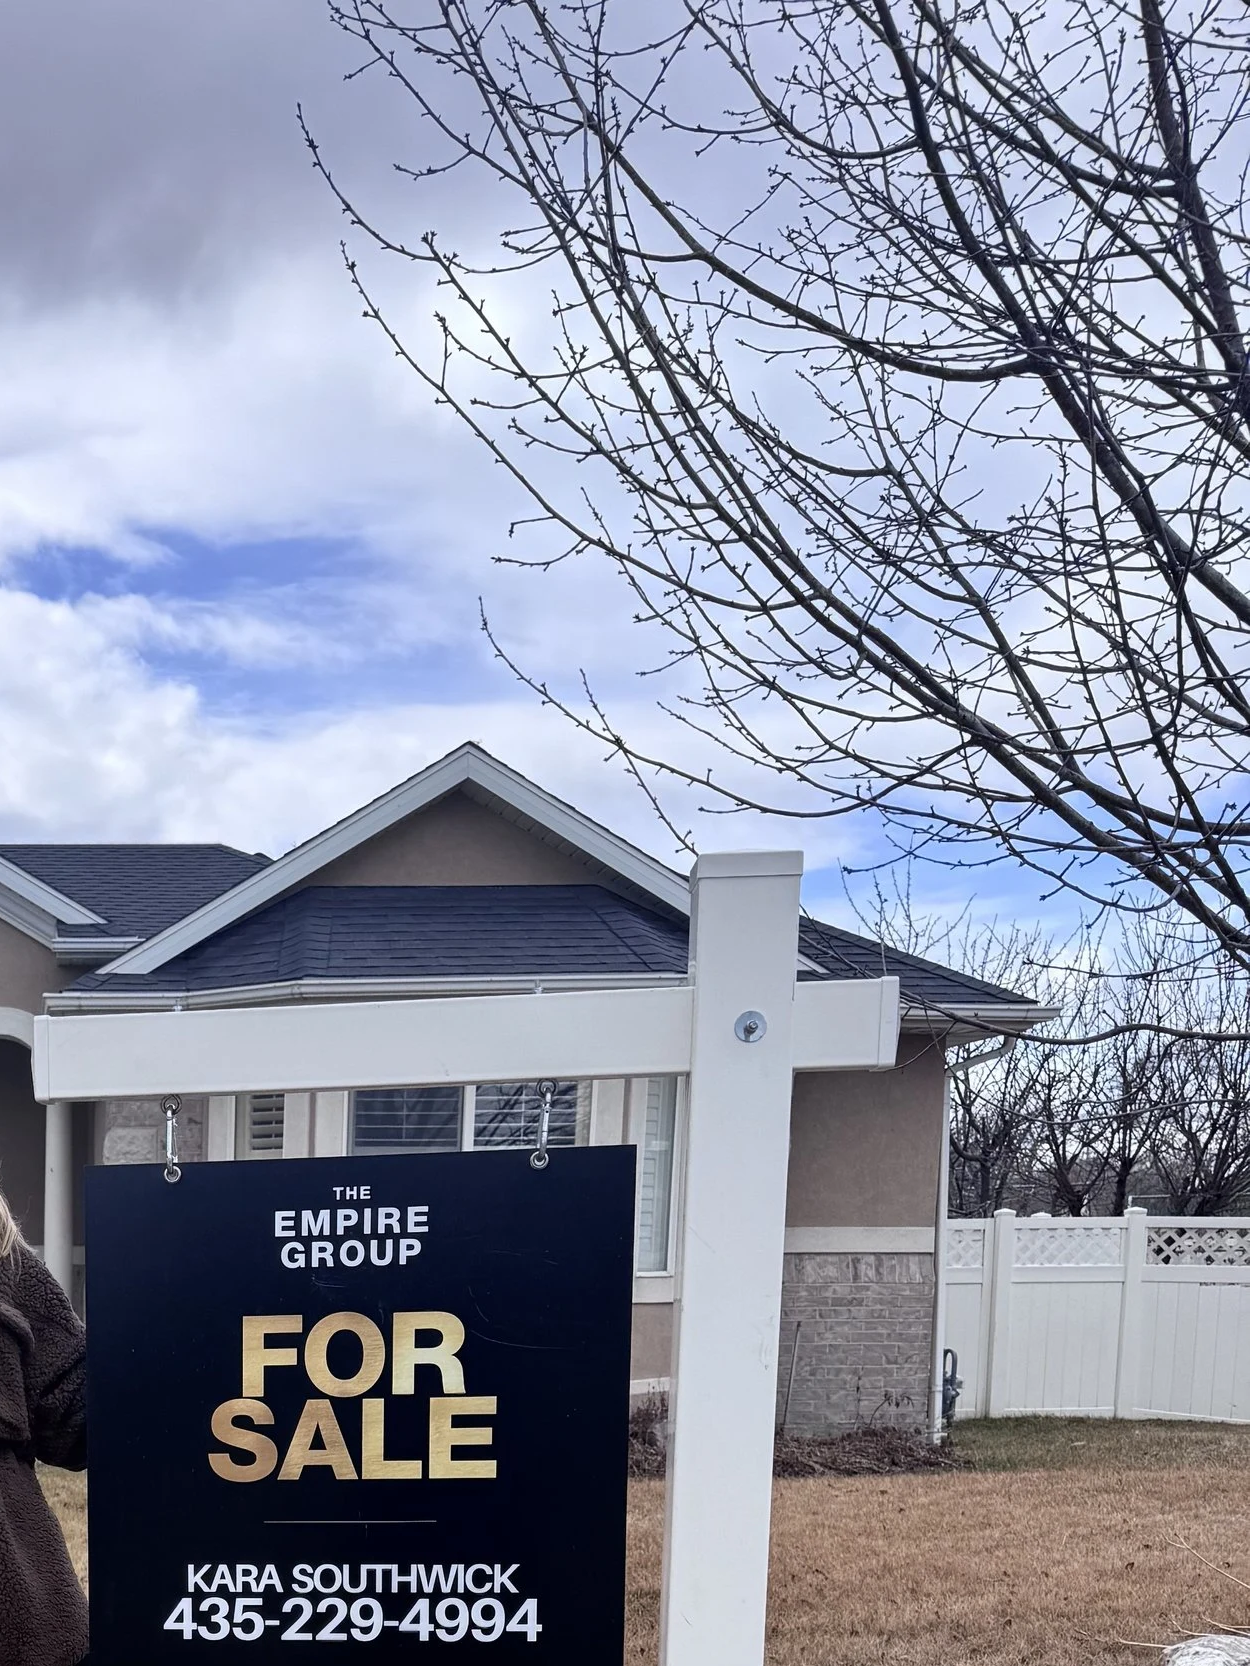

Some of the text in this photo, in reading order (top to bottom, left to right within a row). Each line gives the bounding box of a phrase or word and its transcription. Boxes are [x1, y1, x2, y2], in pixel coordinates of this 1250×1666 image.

[333, 1186, 371, 1200] THE
[275, 1206, 430, 1238] EMPIRE
[281, 1238, 423, 1269] GROUP
[242, 1311, 467, 1398] FOR
[208, 1395, 498, 1483] SALE
[188, 1564, 520, 1593] KARA SOUTHWICK
[163, 1597, 543, 1643] 435-229-4994
